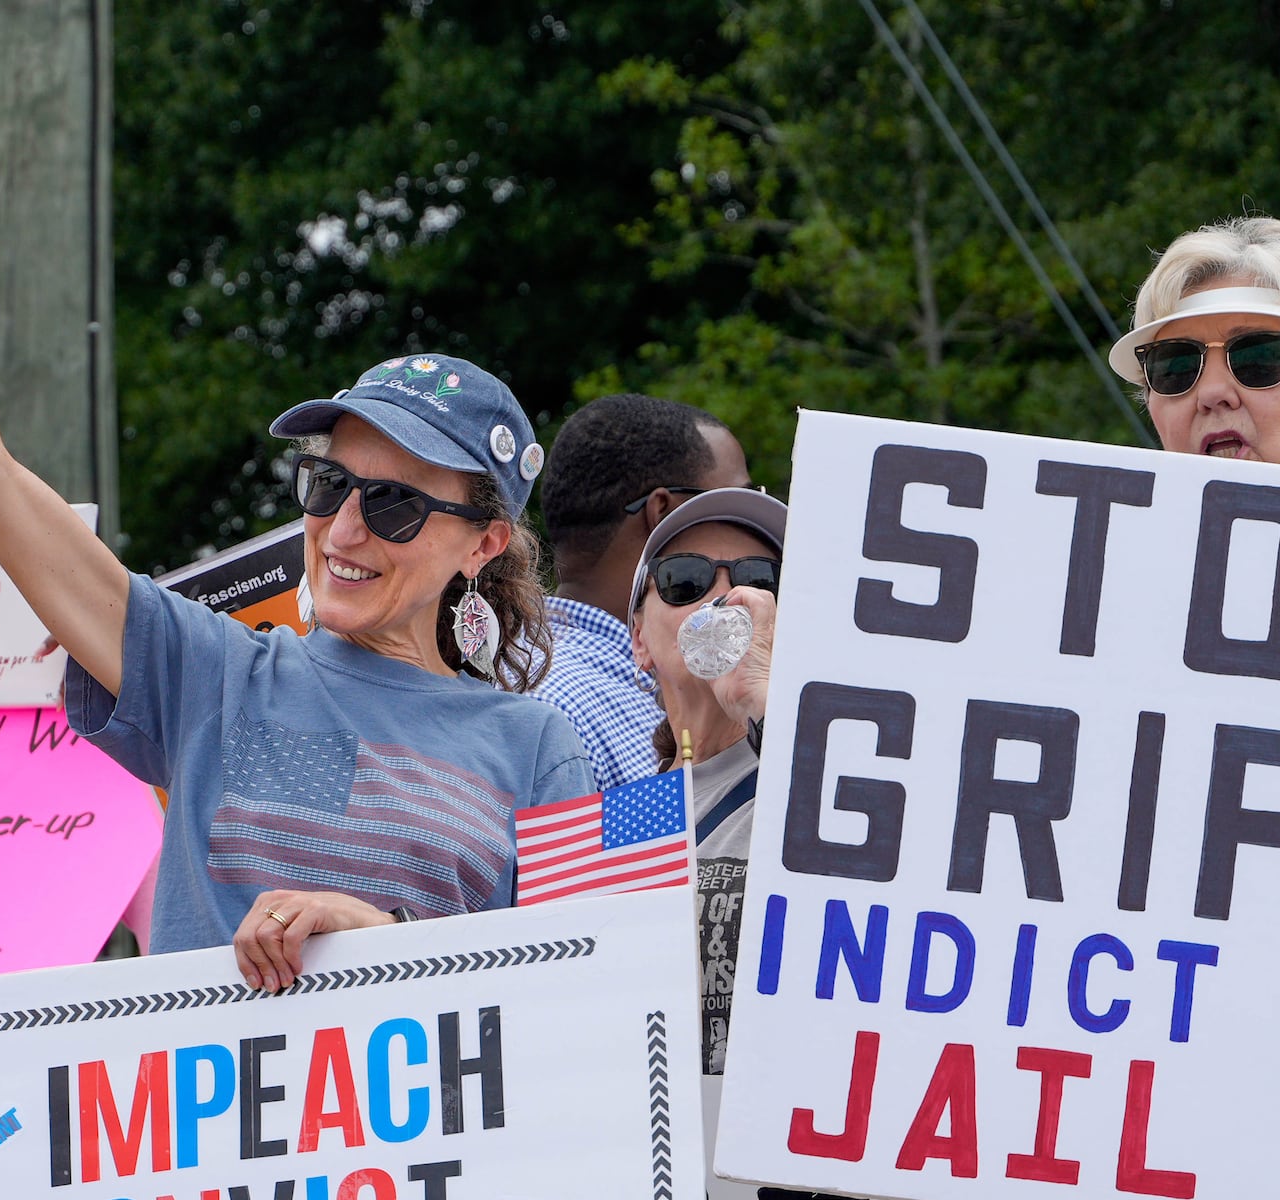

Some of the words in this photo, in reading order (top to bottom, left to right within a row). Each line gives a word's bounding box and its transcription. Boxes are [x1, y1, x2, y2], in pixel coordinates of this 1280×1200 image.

[385, 380, 421, 396] Daisy
[420, 392, 449, 412] Tulip
[757, 894, 1218, 1042] INDICT
[48, 1005, 504, 1188] IMPEACH
[788, 1031, 1196, 1200] JAIL
